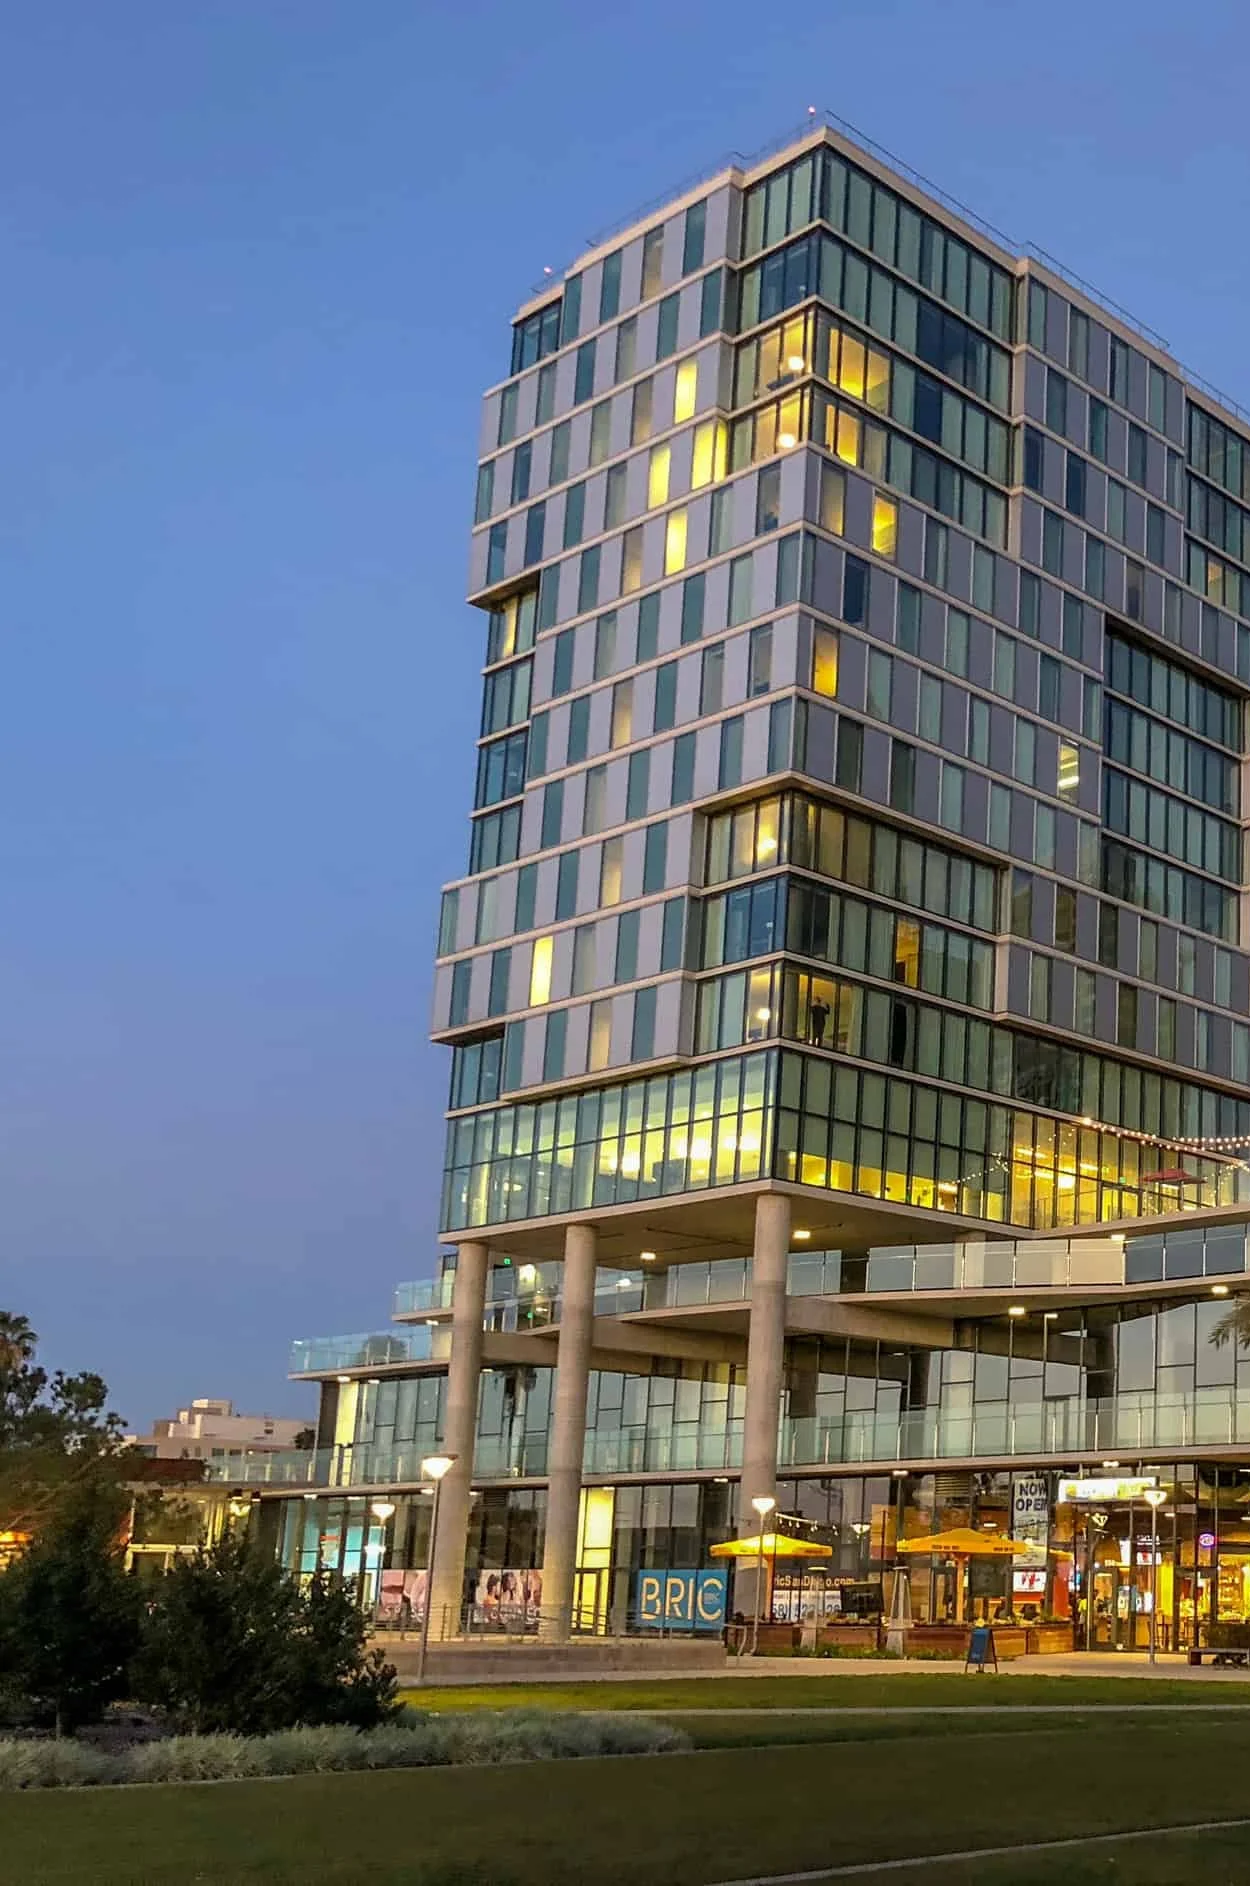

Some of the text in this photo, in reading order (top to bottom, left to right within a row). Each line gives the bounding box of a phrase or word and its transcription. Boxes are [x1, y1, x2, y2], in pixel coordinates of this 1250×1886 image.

[1019, 1482, 1047, 1496] NOW
[1016, 1498, 1048, 1512] OPEN
[641, 1577, 723, 1620] BRIC
